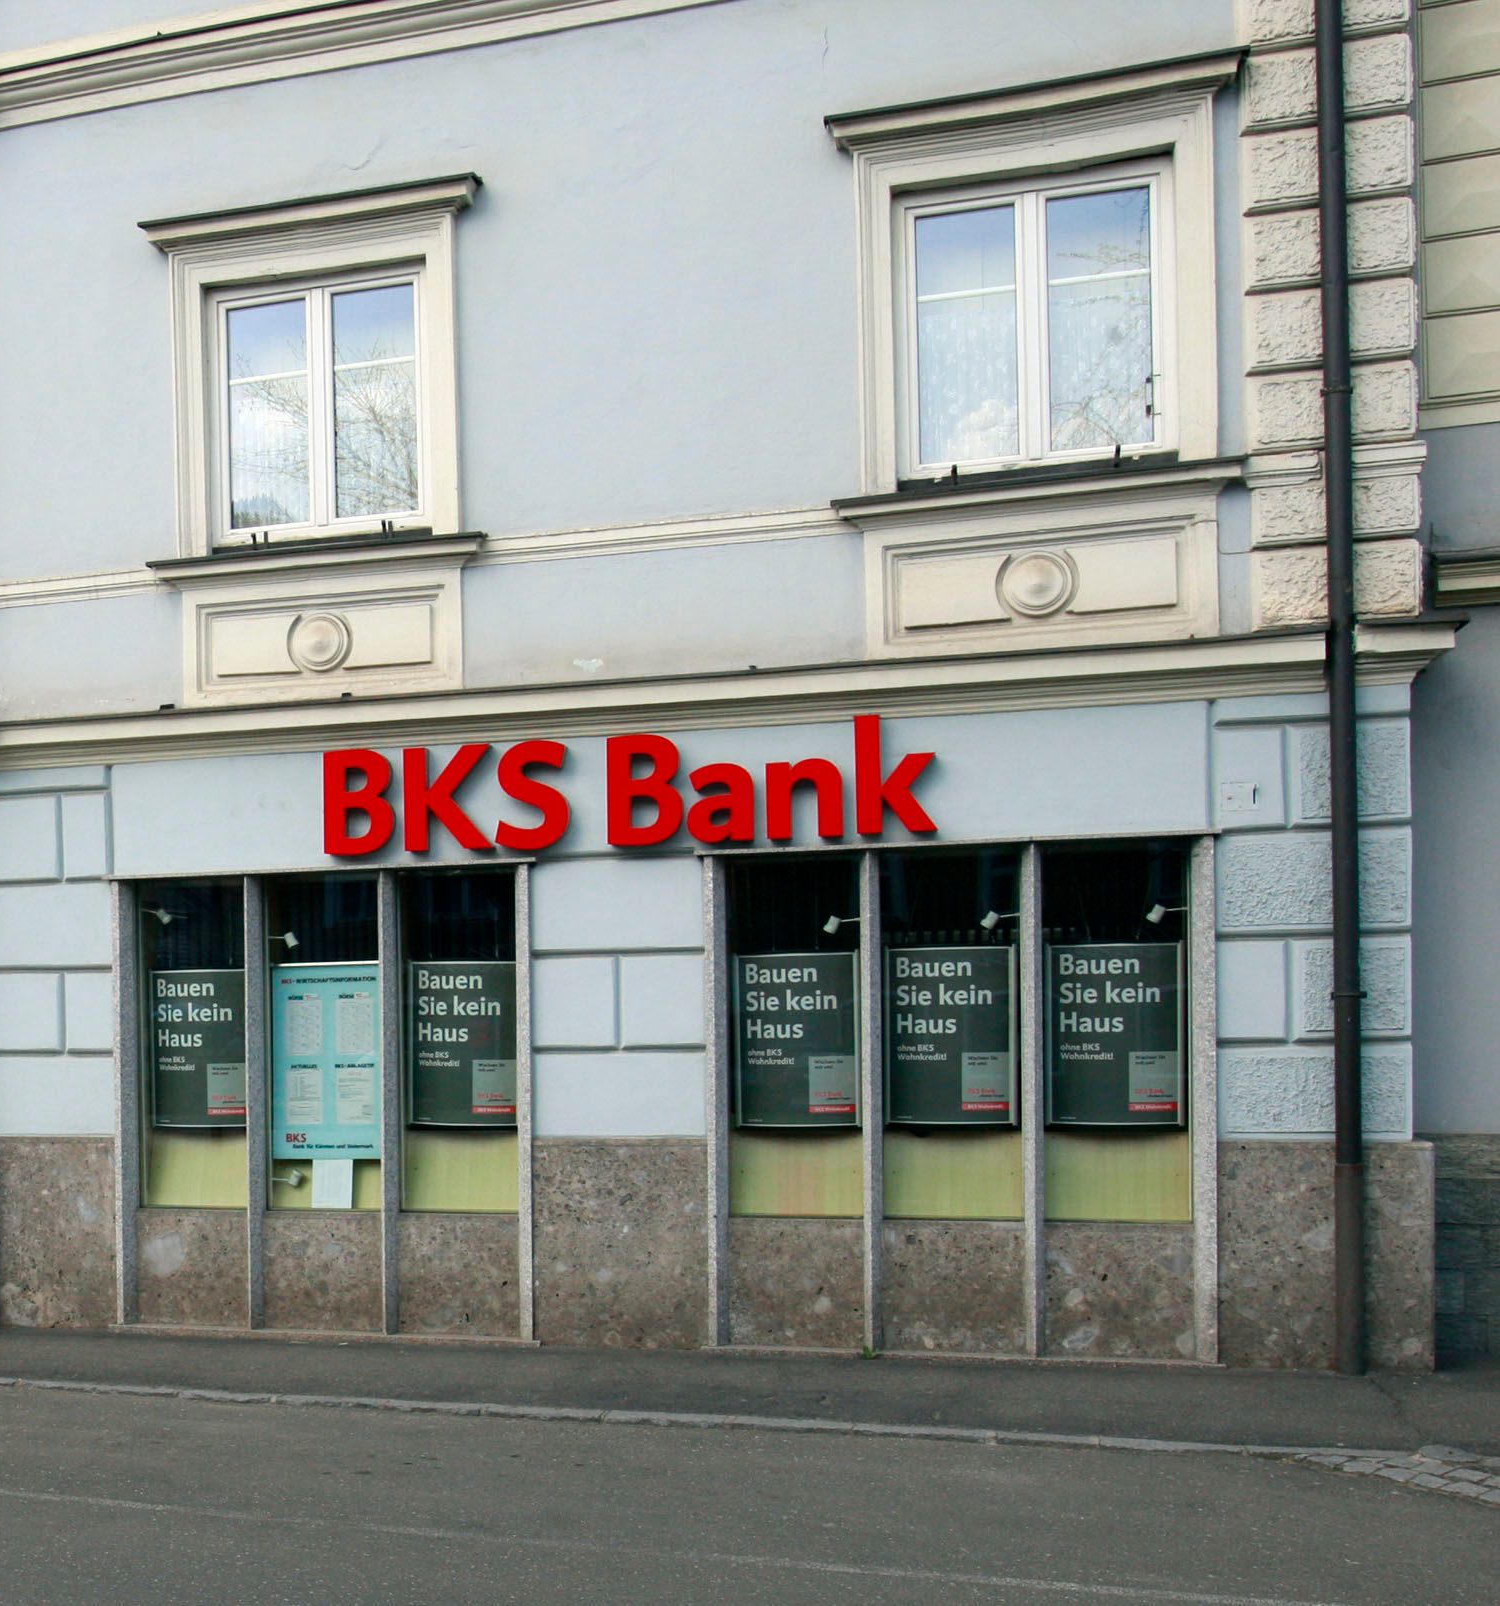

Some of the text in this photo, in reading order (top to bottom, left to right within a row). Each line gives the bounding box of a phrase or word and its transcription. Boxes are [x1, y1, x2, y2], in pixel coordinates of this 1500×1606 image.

[323, 714, 938, 856] BKS Bank
[745, 963, 818, 985] Bauen
[896, 956, 972, 978] Bauen
[1059, 953, 1140, 975] Bauen
[156, 978, 215, 998] Bauen
[418, 969, 483, 990] Bauen
[746, 989, 838, 1012] Sie kein
[896, 983, 993, 1006] Sie kein
[1059, 981, 1161, 1005] Sie kein
[157, 1002, 233, 1022] Sie kein
[418, 995, 501, 1016] Sie kein
[418, 1022, 469, 1042] Haus
[746, 1019, 804, 1039] Haus
[896, 1013, 957, 1034] Haus
[1060, 1012, 1124, 1033] Haus
[158, 1028, 203, 1048] Haus
[897, 1044, 935, 1052] ohne BKS
[1060, 1043, 1101, 1051] ohne BKS
[766, 1049, 782, 1057] BKS
[285, 1132, 307, 1143] BKS
